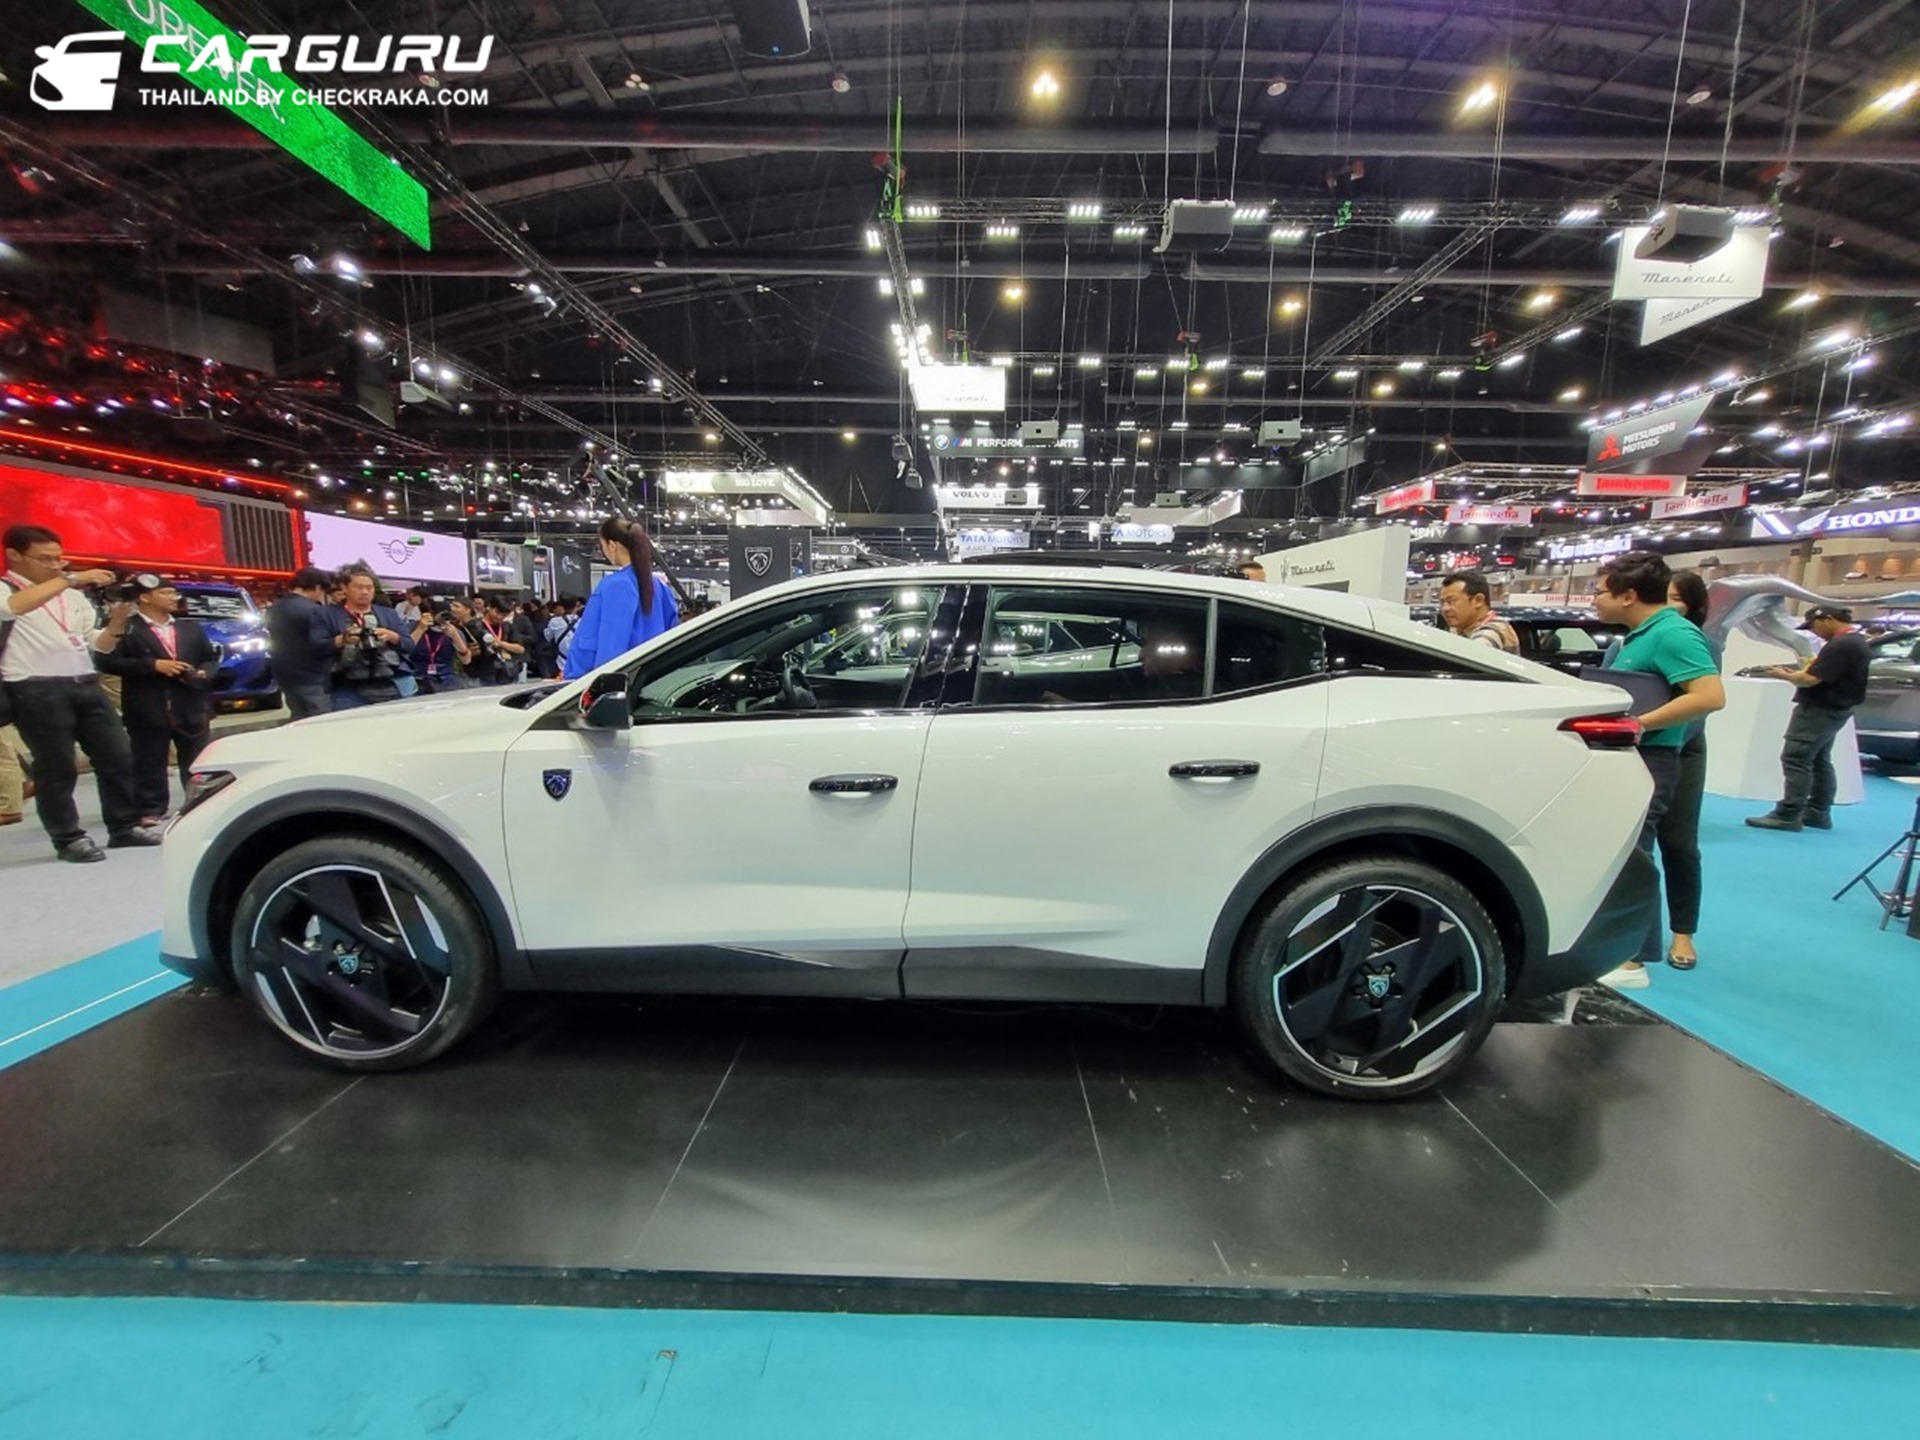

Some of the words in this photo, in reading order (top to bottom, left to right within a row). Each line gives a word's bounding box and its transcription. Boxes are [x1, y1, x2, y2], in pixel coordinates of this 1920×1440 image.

[1641, 272, 1734, 285] Maserati
[1621, 436, 1661, 455] MOTORS
[960, 534, 987, 543] TATA
